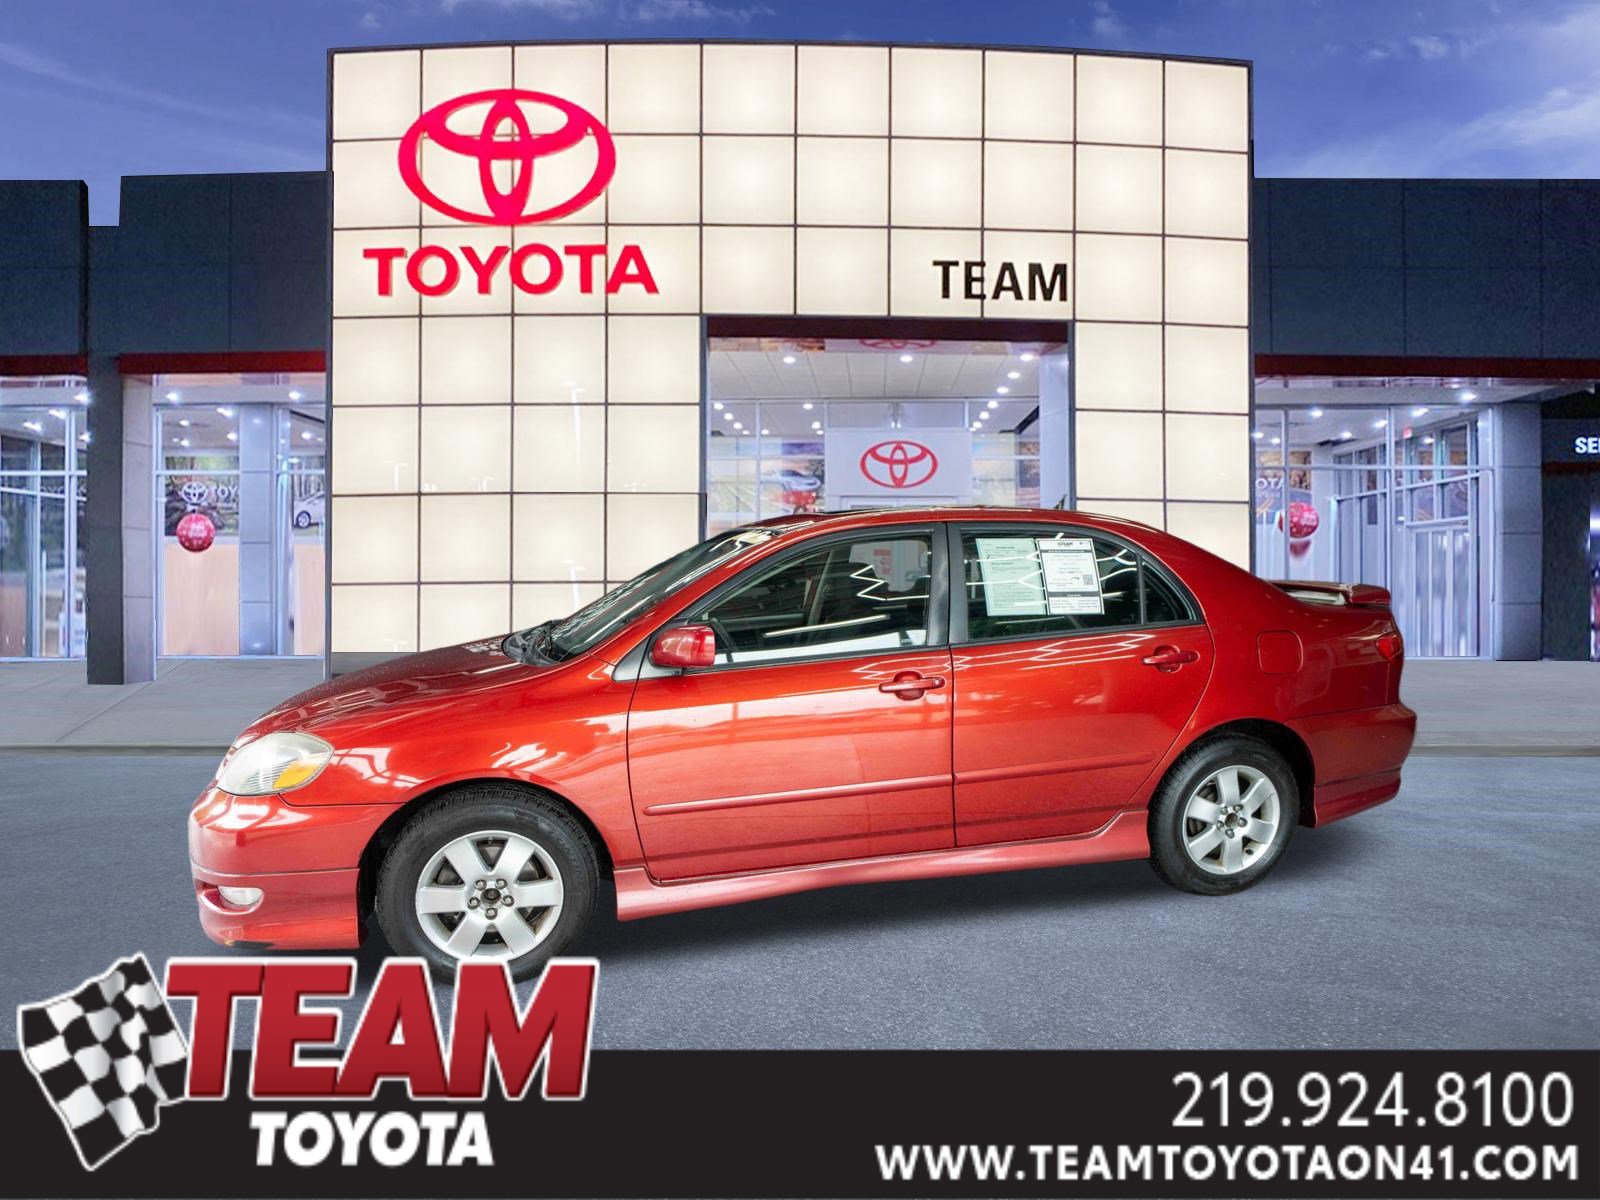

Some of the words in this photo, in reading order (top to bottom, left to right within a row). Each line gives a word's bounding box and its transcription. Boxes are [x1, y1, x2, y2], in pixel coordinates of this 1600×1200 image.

[363, 243, 660, 297] TOYOTA
[932, 260, 1069, 302] TEAM
[1575, 437, 1600, 454] SE
